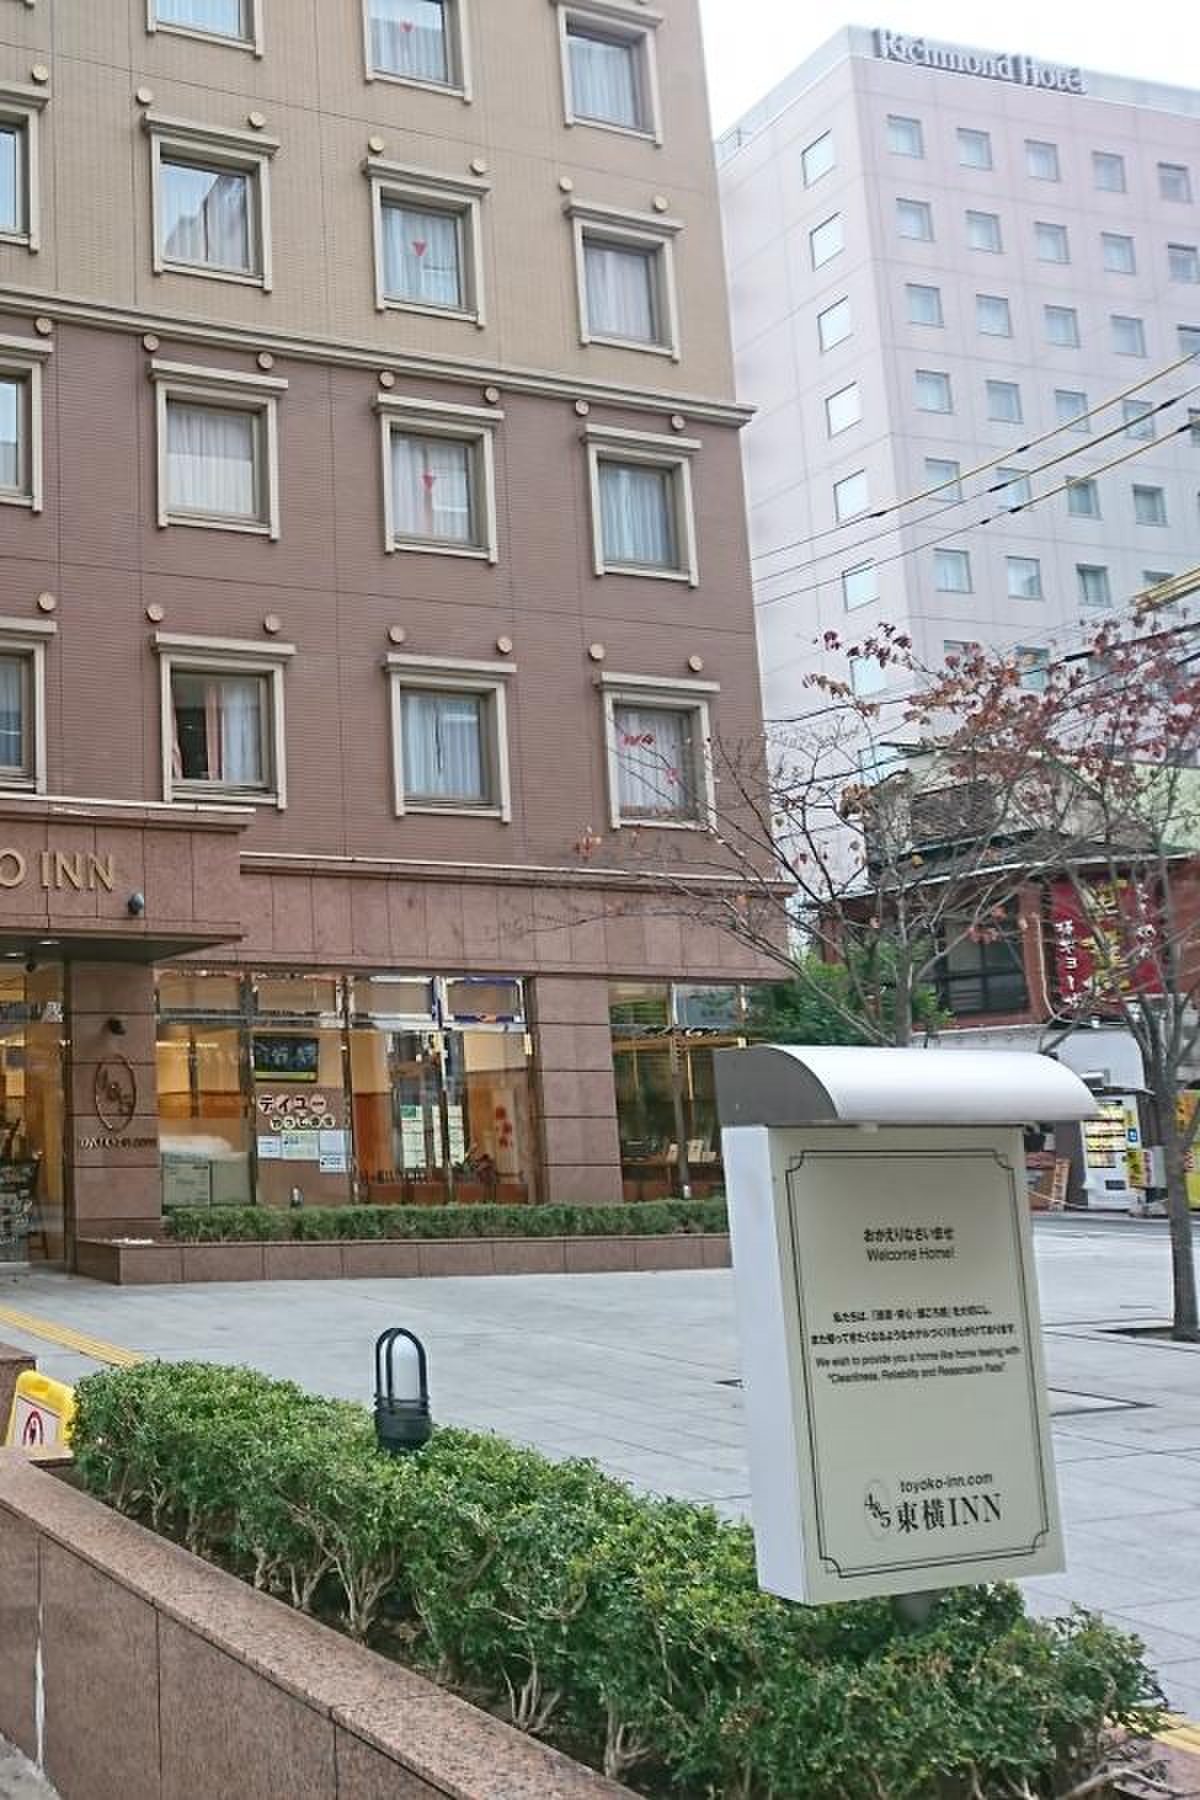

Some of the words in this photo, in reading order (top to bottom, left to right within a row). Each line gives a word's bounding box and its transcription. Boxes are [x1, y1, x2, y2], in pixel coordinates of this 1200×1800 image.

[39, 851, 115, 892] INN
[867, 1248, 916, 1262] Welcome
[920, 1247, 955, 1260] Home!
[900, 1472, 993, 1494] toyoko-inn.com
[897, 1492, 1003, 1533] 東横INN
